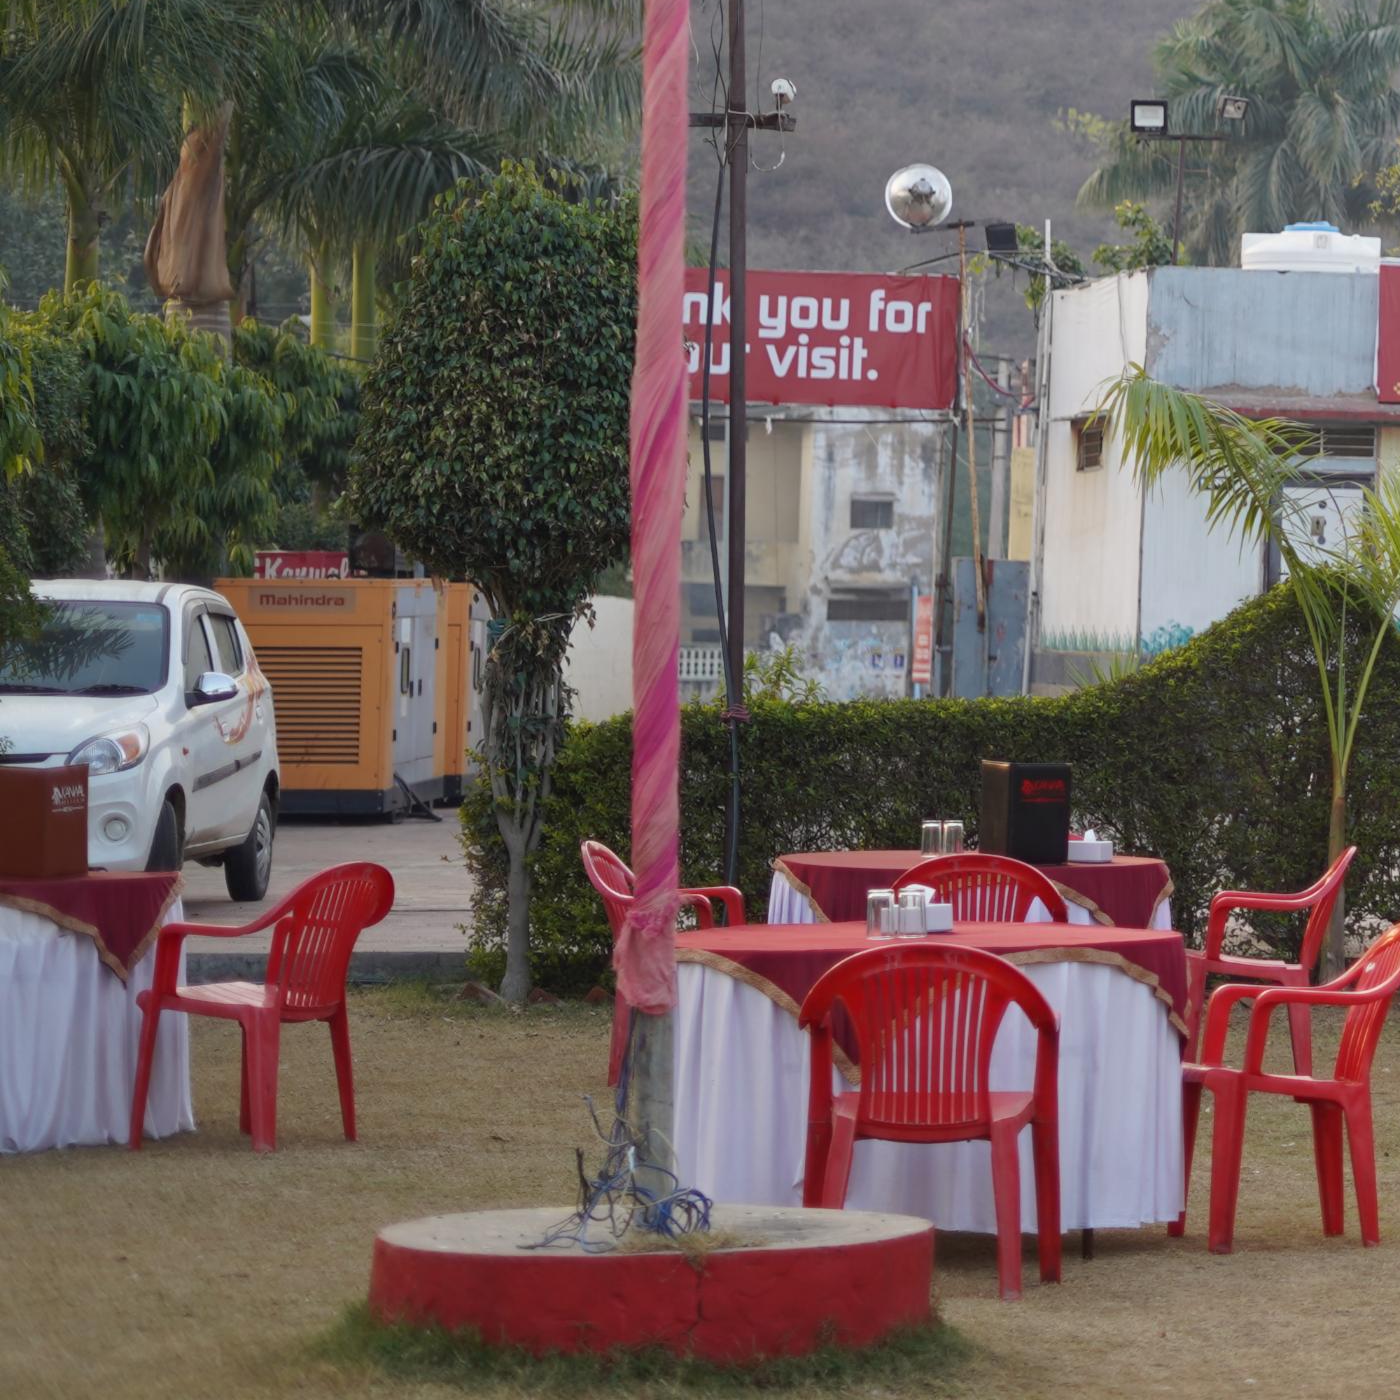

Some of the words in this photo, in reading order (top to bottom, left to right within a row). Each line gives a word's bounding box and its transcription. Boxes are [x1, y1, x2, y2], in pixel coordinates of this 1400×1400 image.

[758, 290, 850, 339] you
[869, 289, 932, 333] for
[765, 333, 879, 381] visit.
[259, 594, 345, 607] Mahindra
